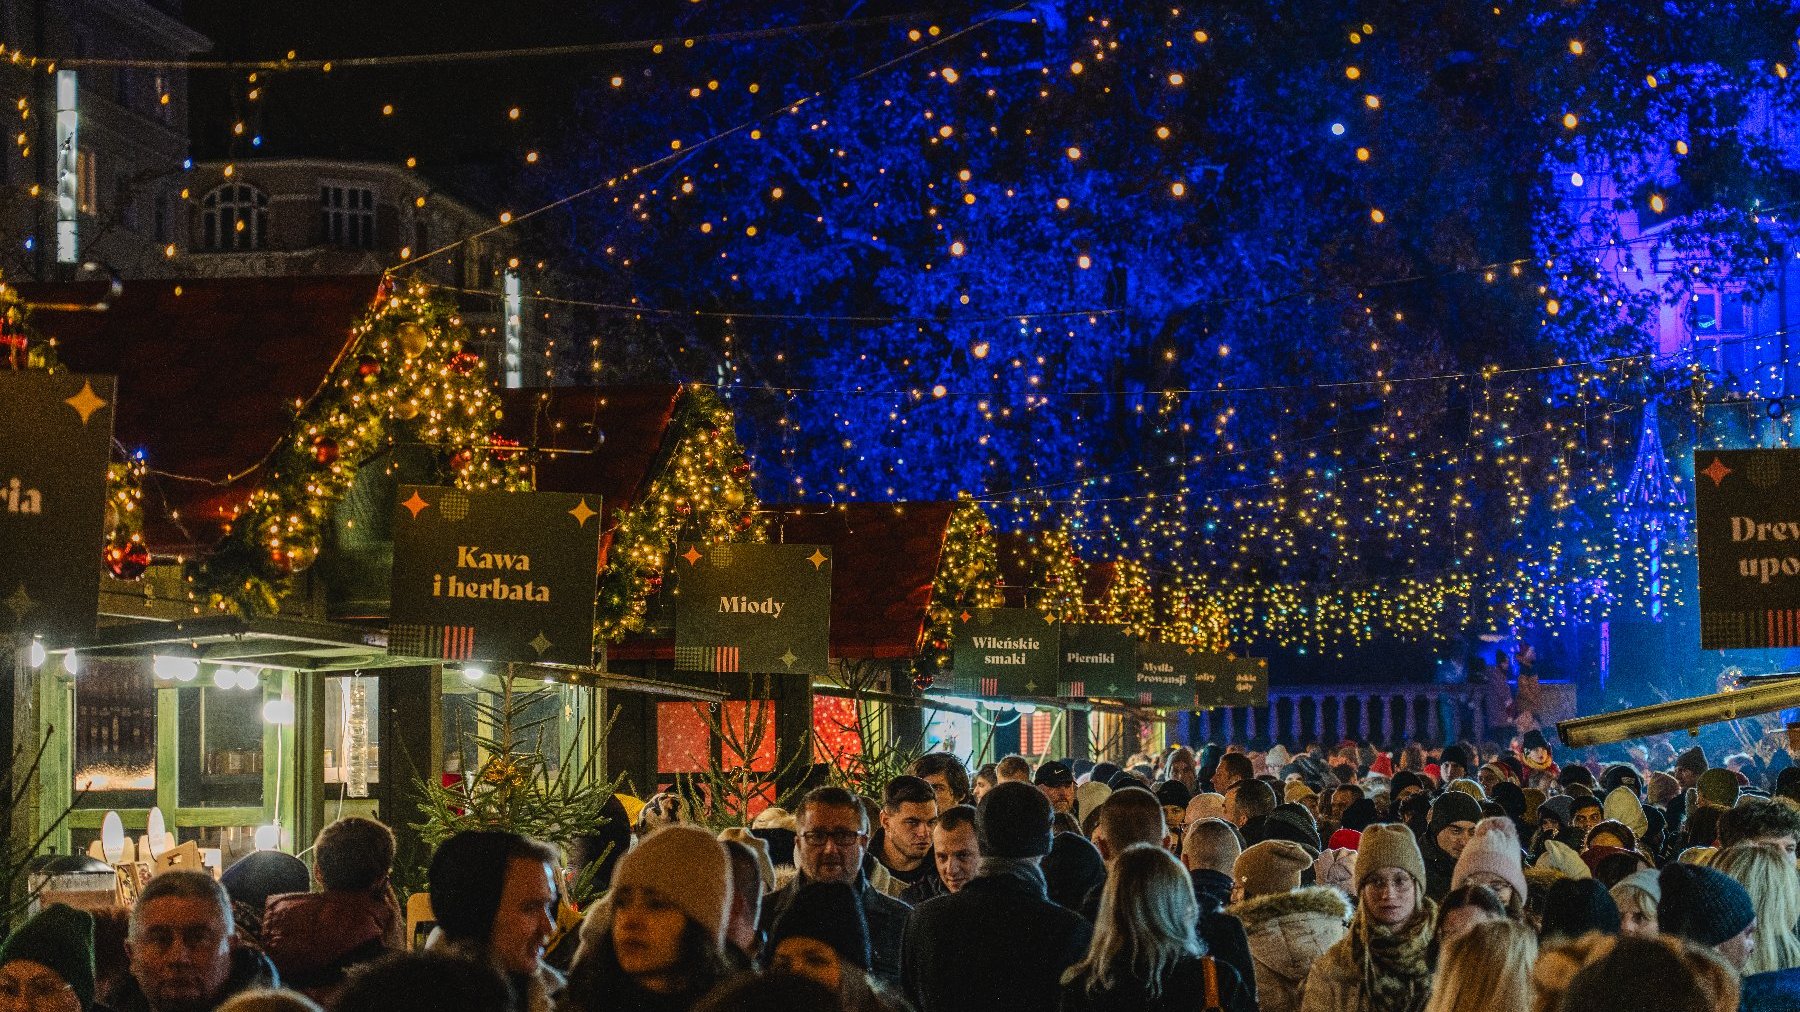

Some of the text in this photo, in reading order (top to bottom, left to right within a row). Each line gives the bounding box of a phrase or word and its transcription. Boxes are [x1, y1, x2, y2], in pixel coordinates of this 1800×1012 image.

[456, 546, 530, 571] Kawa
[432, 574, 550, 602] i herbata
[718, 596, 785, 618] Miody
[972, 636, 1040, 650] Wileńskie
[984, 652, 1026, 665] smaki
[1066, 652, 1115, 664] Pierniki
[1143, 662, 1174, 673] Mydła
[1136, 673, 1187, 686] Prowansji
[1195, 673, 1216, 683] ofry
